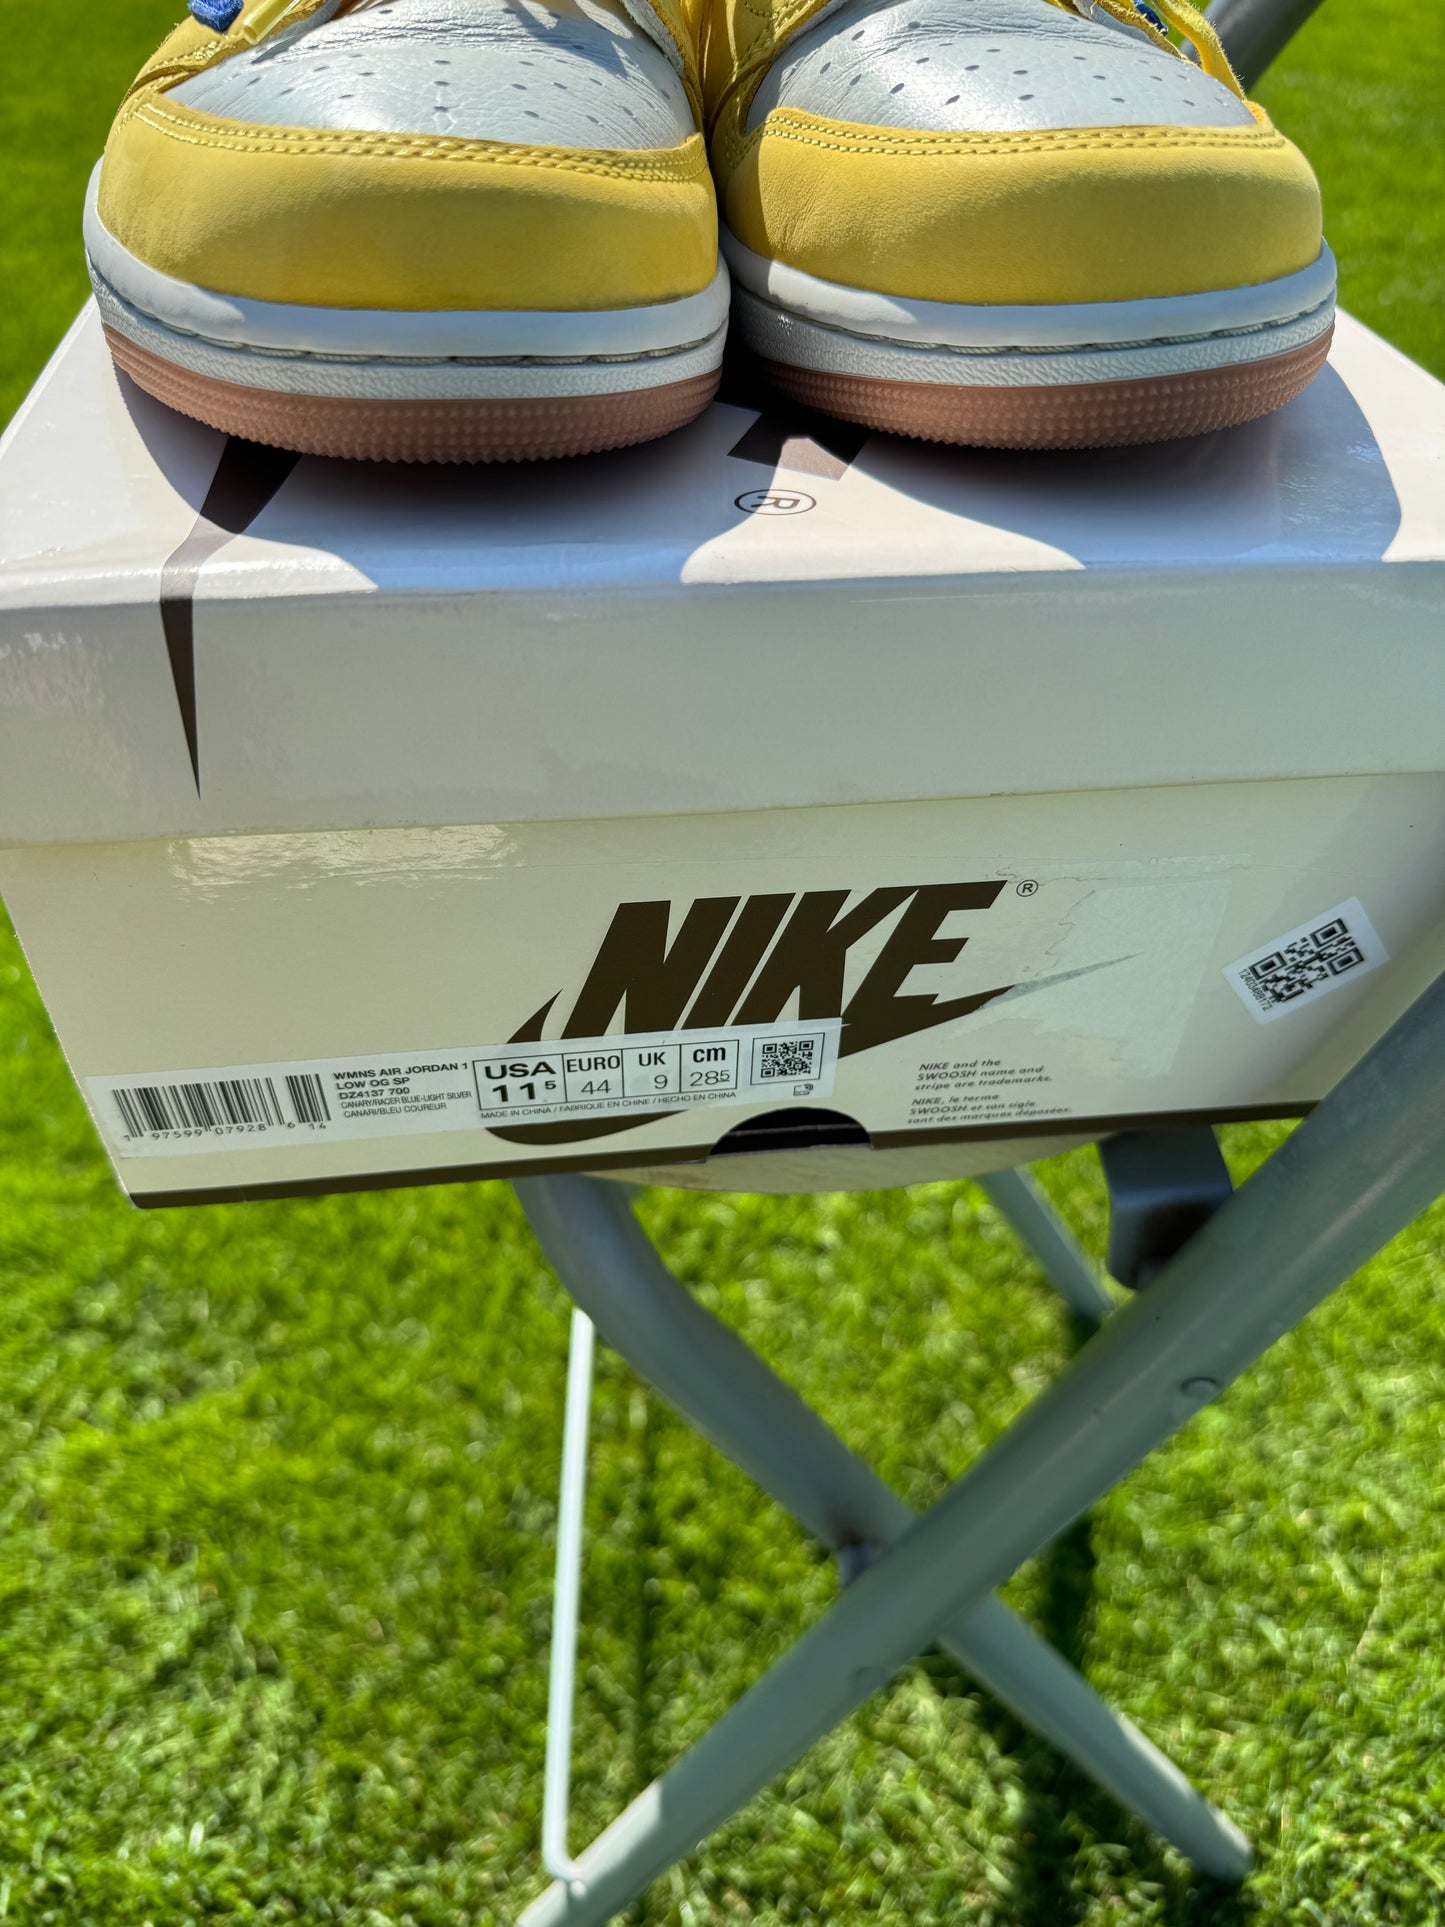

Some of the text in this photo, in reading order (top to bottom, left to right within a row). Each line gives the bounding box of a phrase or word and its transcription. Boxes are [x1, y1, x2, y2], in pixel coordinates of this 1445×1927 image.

[560, 879, 1007, 1040] NIKE
[638, 1051, 666, 1067] UK
[693, 1044, 727, 1063] cm
[333, 1062, 468, 1080] WMNS AIR JORDAN 1
[484, 1061, 556, 1080] USA
[566, 1054, 621, 1073] EURO
[919, 1059, 1001, 1071] NIKE and the
[917, 1065, 1044, 1081] SWOOSH name and
[336, 1077, 410, 1090] LOW OG SP
[581, 1079, 612, 1096] 44
[654, 1074, 668, 1090] 9
[914, 1082, 950, 1091] stripe
[978, 1075, 1052, 1087] trademarks.
[339, 1087, 410, 1100] DZ4137 700
[341, 1091, 472, 1109] CANARY/RACER BLUE-LIGHT SILVER
[911, 1097, 945, 1106] NIKE,
[963, 1094, 999, 1102] terme
[343, 1102, 447, 1118] CANARI/BLEU COUREUR
[481, 1110, 508, 1119] MADE
[522, 1107, 552, 1115] CHINA
[559, 1102, 605, 1112] FABRIQUE
[622, 1098, 650, 1106] CHINE
[658, 1095, 691, 1103] HECHO
[694, 1093, 705, 1101] EN
[909, 1105, 967, 1115] SWOOSH
[1009, 1100, 1036, 1109] sigle
[937, 1114, 957, 1122] des
[960, 1111, 1012, 1120] marques
[152, 1128, 203, 1141] 97599
[215, 1123, 267, 1136] 07928
[287, 1121, 296, 1129] 6
[309, 1122, 327, 1131] 14
